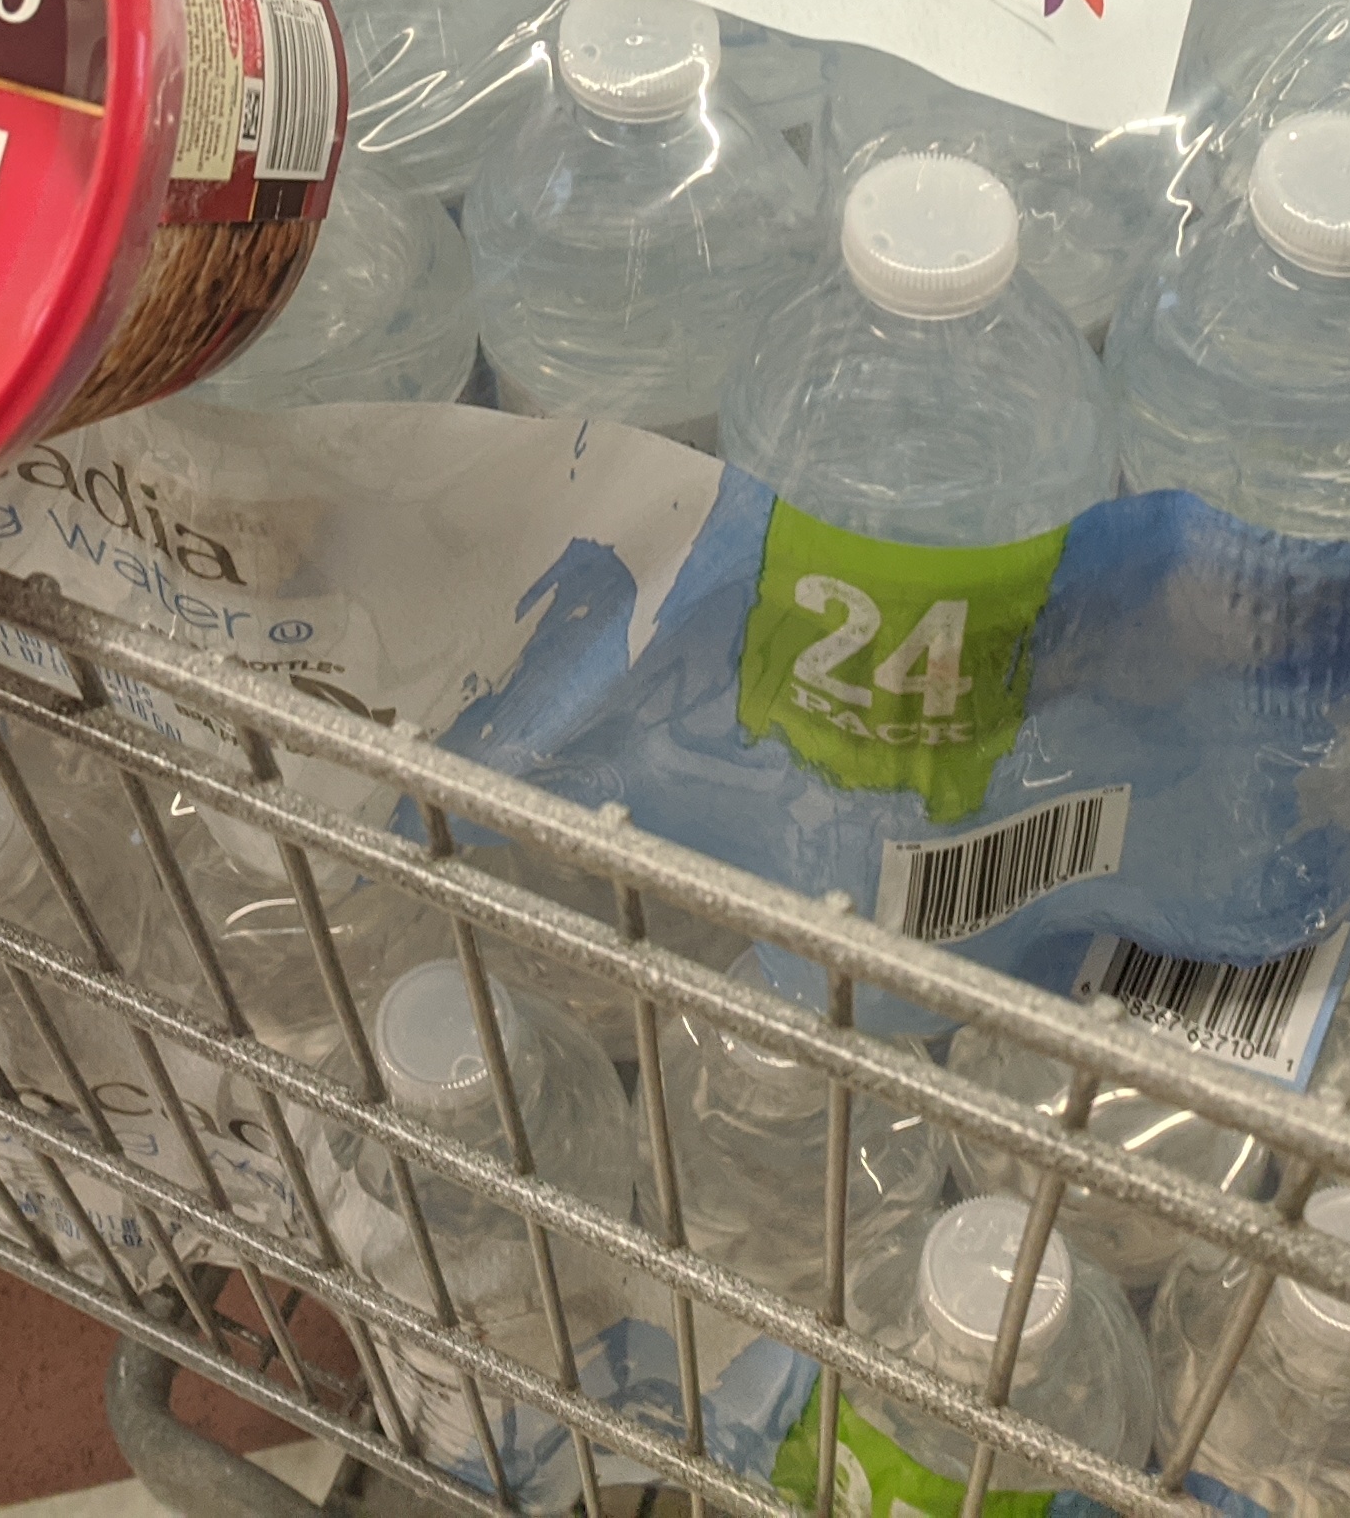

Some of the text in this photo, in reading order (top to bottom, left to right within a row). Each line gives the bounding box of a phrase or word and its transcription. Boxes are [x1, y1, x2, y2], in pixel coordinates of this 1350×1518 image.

[46, 505, 253, 642] water
[793, 574, 972, 716] 24
[789, 686, 974, 747] PACK
